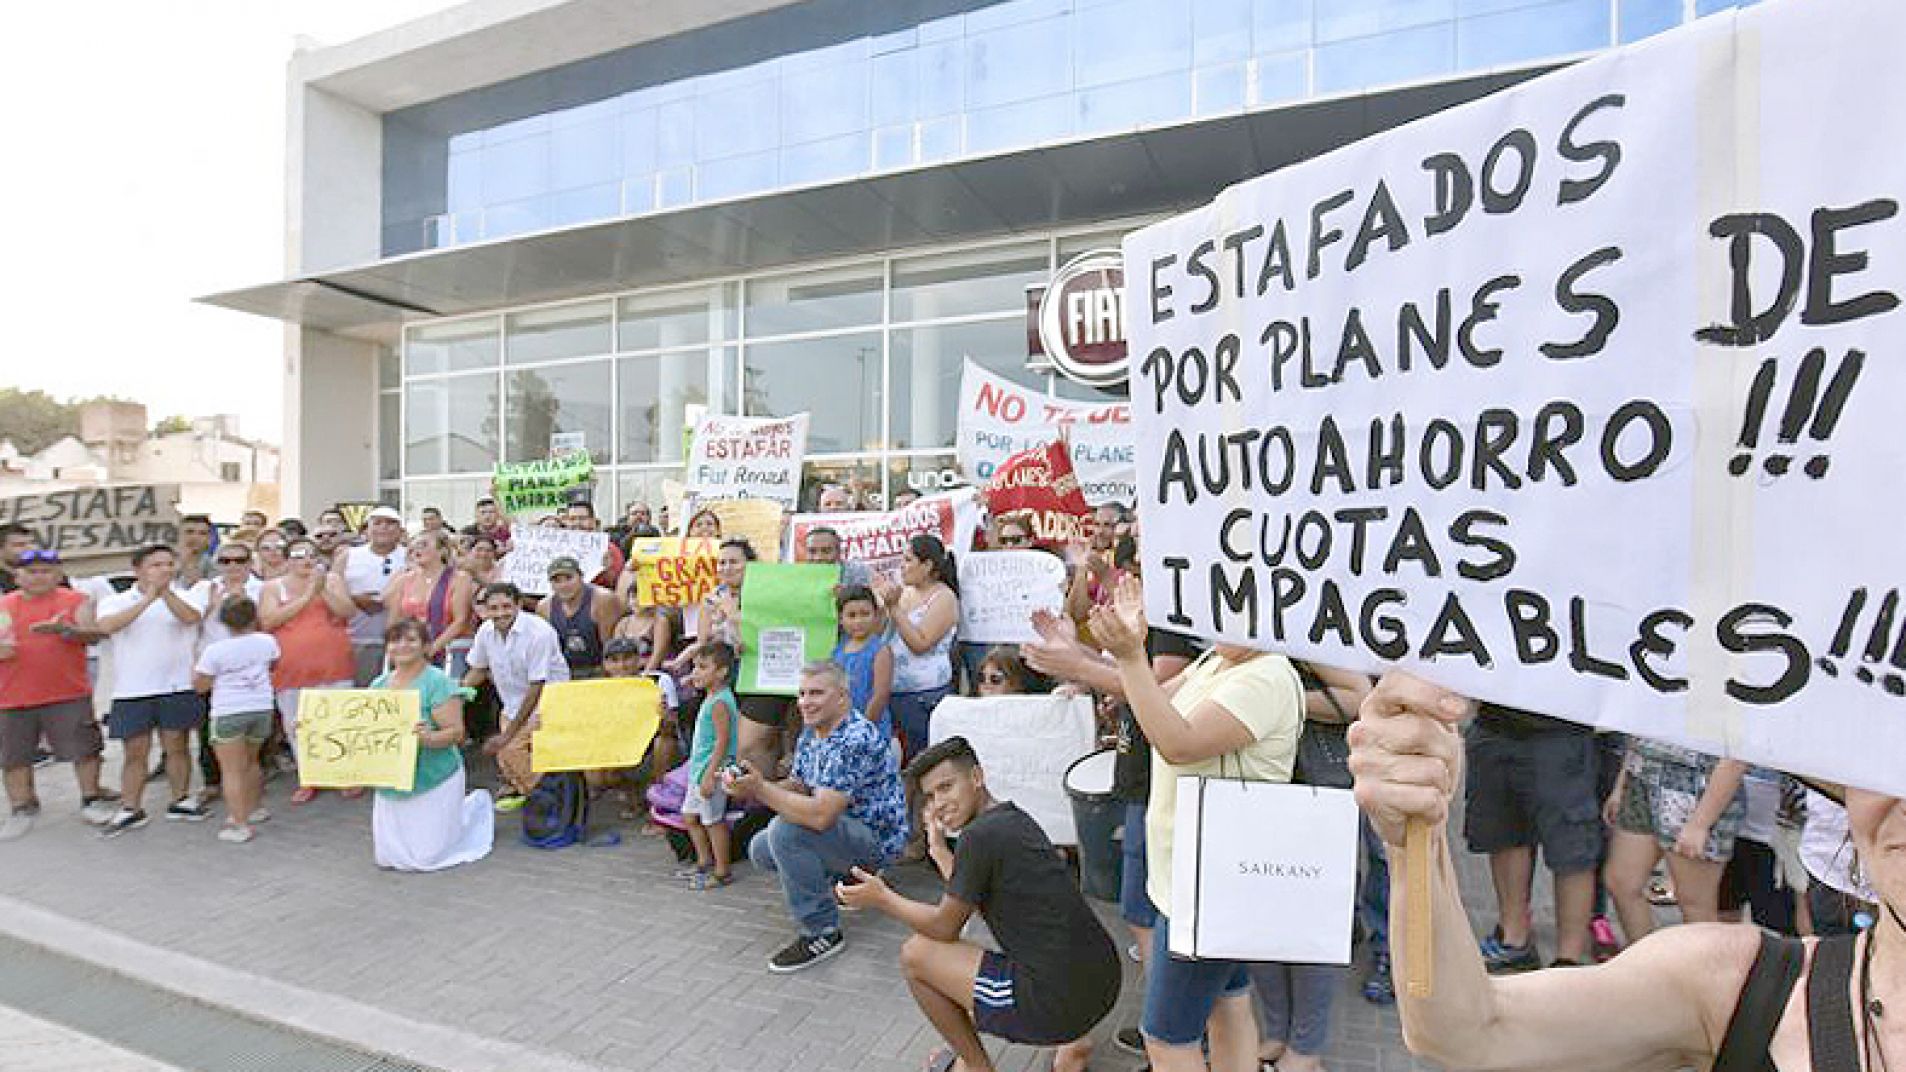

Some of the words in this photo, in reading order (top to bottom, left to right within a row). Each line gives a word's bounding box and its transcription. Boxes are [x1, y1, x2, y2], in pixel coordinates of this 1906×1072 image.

[1152, 95, 1626, 324] ESTAFADOS
[1140, 333, 1241, 414] POR
[1260, 246, 1623, 392] PLANES
[1694, 198, 1901, 346] DE
[974, 381, 1026, 424] NO
[706, 437, 791, 459] ESTAFAR
[1219, 505, 1517, 582] CUOTAS
[1238, 861, 1322, 879] SARKANY
